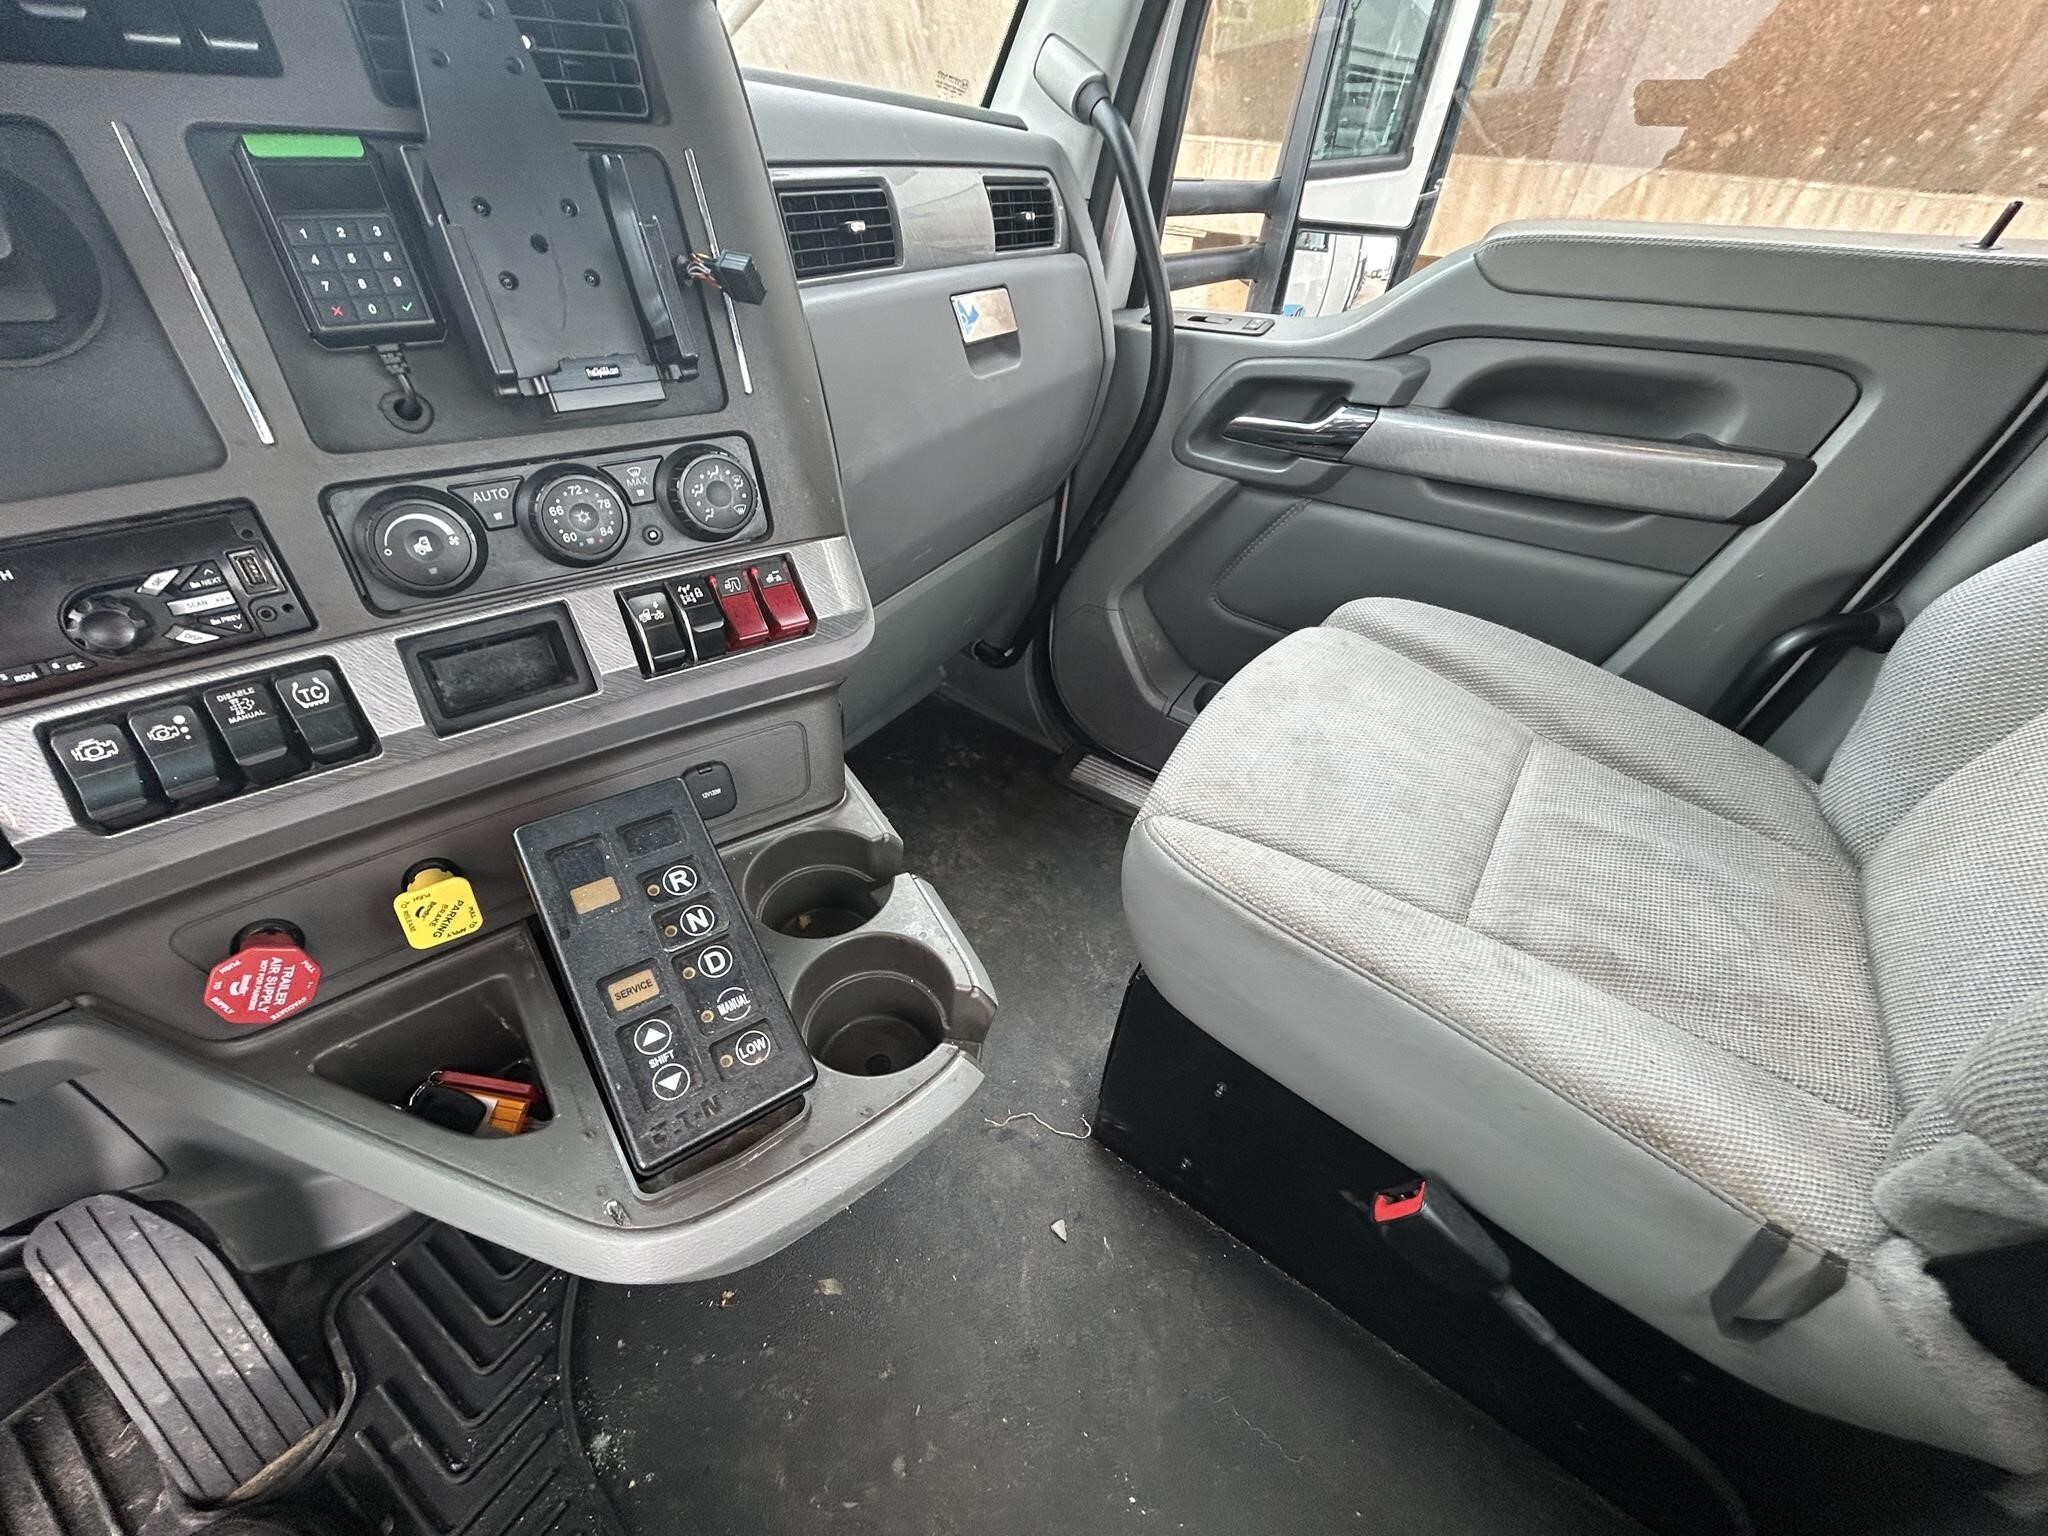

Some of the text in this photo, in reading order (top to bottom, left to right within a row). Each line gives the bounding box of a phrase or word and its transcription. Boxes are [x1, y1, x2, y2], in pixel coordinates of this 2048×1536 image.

[300, 228, 308, 238] 1
[336, 227, 346, 238] 2
[373, 226, 382, 237] 3
[312, 254, 320, 265] 4
[347, 253, 356, 264] 5
[384, 252, 392, 262] 6
[321, 281, 329, 291] 7
[358, 278, 367, 289] 8
[393, 276, 402, 287] 9
[368, 304, 377, 314] 0
[626, 478, 649, 487] MAX
[473, 487, 509, 503] AUTO
[568, 486, 583, 496] 72
[597, 499, 611, 509] 78
[549, 506, 564, 517] 66
[600, 526, 614, 536] 84
[563, 532, 577, 543] 60
[201, 577, 221, 586] NEXT
[220, 614, 241, 623] PREV
[216, 687, 255, 702] DISABLE
[298, 686, 324, 702] TC
[228, 709, 267, 724] MANUAL
[668, 870, 692, 892] R
[429, 903, 448, 927] BRAKE
[433, 900, 464, 938] PARKING
[685, 908, 710, 933] N
[704, 951, 726, 974] D
[213, 981, 222, 990] TO
[258, 956, 283, 1013] AIR SUPPLY
[273, 964, 295, 1006] TRAILER
[614, 979, 653, 1001] SERVICE
[717, 994, 750, 1016] MANUAL
[738, 1037, 766, 1059] LOW
[649, 1049, 675, 1068] SHIFT
